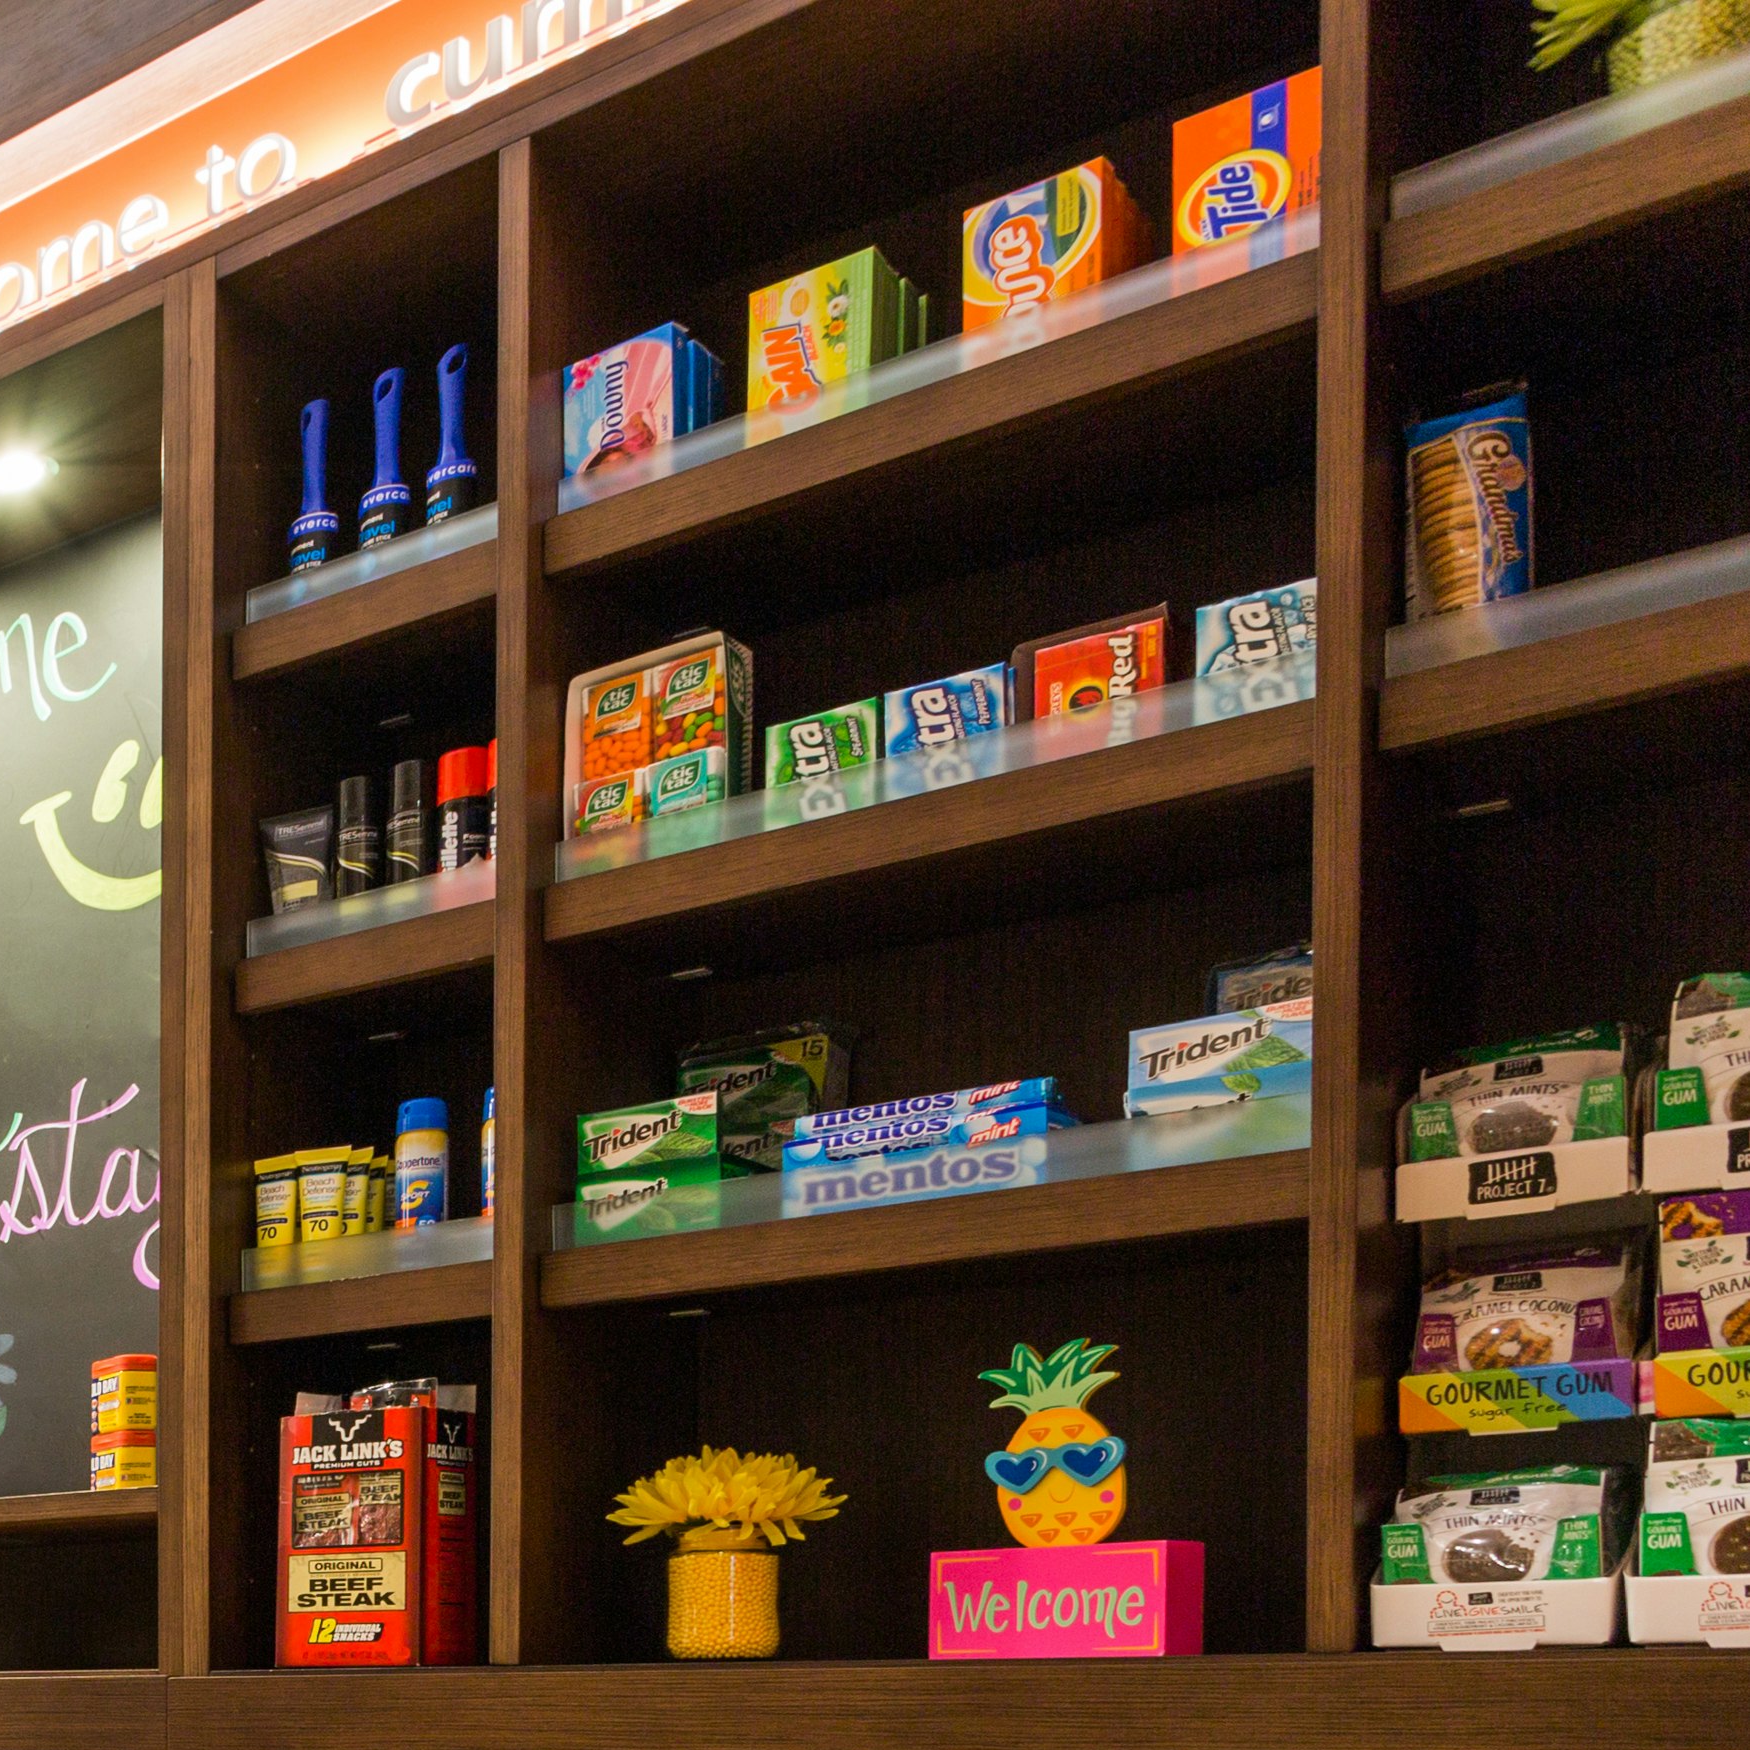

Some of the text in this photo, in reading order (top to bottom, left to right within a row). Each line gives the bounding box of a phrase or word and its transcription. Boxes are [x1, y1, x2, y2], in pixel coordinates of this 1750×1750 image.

[195, 132, 298, 202] to
[1206, 162, 1272, 241] Tide
[762, 324, 821, 416] GAIN
[599, 360, 629, 451] Downy
[681, 664, 704, 681] tic
[1108, 632, 1138, 699] Red
[674, 675, 703, 690] tac
[609, 686, 630, 702] tic
[603, 697, 629, 712] tac
[673, 764, 695, 781] tic
[666, 775, 695, 790] tac
[601, 784, 622, 801] tic
[593, 795, 621, 810] tac
[801, 1038, 824, 1059] 15
[1138, 1016, 1272, 1081] Trident
[1469, 1090, 1503, 1108] THIN
[1663, 1089, 1698, 1106] GUM
[812, 1093, 958, 1129] mentos
[583, 1108, 684, 1164] Trident
[967, 1118, 1022, 1149] mint
[1417, 1122, 1448, 1138] GUM
[396, 1155, 441, 1172] Coppertone
[306, 1177, 336, 1188] Beach
[803, 1150, 1018, 1206] mentos
[260, 1183, 285, 1196] Beach
[302, 1186, 338, 1198] Defense
[1477, 1178, 1547, 1201] PROJECT 7
[583, 1177, 668, 1223] Trident
[260, 1226, 278, 1240] 70
[309, 1218, 329, 1233] 70
[1664, 1316, 1699, 1331] GUM
[1423, 1336, 1451, 1350] GUM
[101, 1377, 119, 1393] BAY
[1426, 1371, 1615, 1406] GOURMET GUM
[1468, 1402, 1568, 1421] sugar free
[292, 1438, 404, 1466] JACK LINK'S
[427, 1442, 449, 1460] JACK
[99, 1453, 115, 1469] BAY
[313, 1459, 381, 1471] PREMIUM CUTS
[361, 1485, 399, 1496] BEEF
[301, 1495, 345, 1507] ORIGINAL
[1707, 1497, 1746, 1516] THIN
[304, 1510, 342, 1521] BEEF
[1444, 1514, 1538, 1530] THIN MINTS
[298, 1519, 350, 1531] STEAK
[1563, 1519, 1589, 1531] THIN
[1646, 1524, 1683, 1537] GOURMET
[1386, 1534, 1418, 1545] GOURMET
[1647, 1534, 1683, 1550] GUM
[1387, 1544, 1419, 1559] GUM
[314, 1559, 377, 1572] ORIGINAL
[309, 1577, 384, 1593] BEEF
[296, 1591, 396, 1608] STEAK
[943, 1580, 1146, 1639] Welcome
[308, 1617, 337, 1644] 12
[334, 1624, 381, 1633] INDIVIDUAL
[333, 1632, 374, 1642] SNACKS
